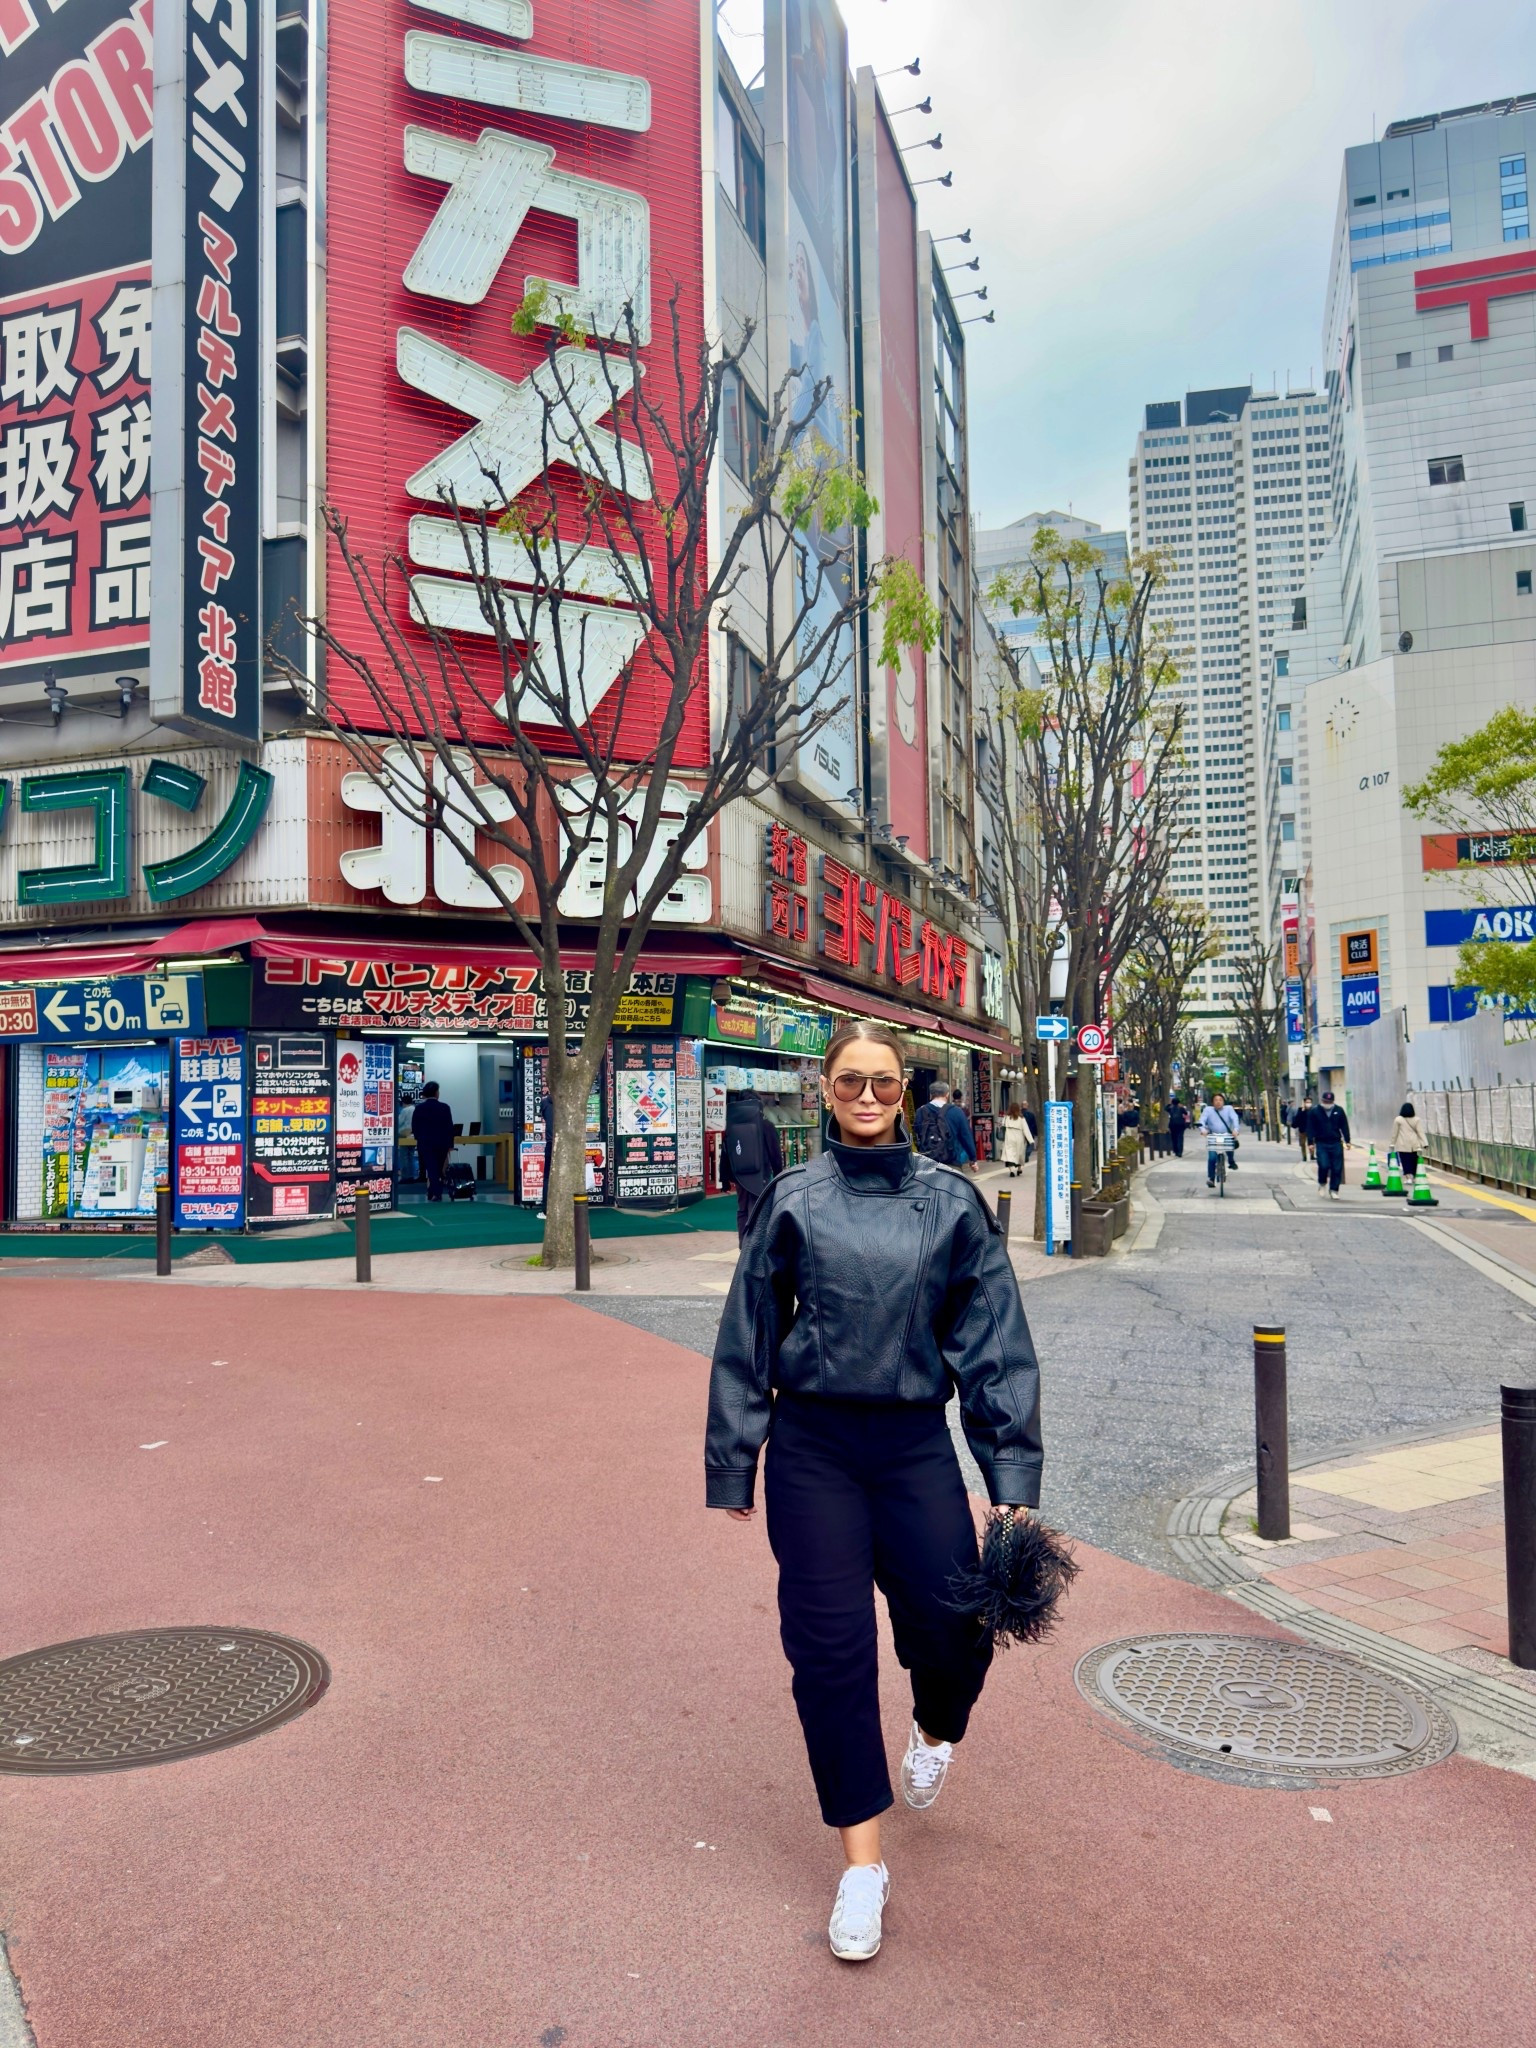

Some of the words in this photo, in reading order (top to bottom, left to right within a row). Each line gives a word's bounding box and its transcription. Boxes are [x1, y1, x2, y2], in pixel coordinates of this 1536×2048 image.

[0, 0, 152, 254] STOR
[813, 743, 841, 783] ASUS
[1372, 771, 1391, 786] 107
[0, 757, 275, 906] コン
[820, 853, 968, 1007] ヨドバシカメラ
[1351, 950, 1369, 960] CLUB
[83, 986, 112, 999] この先
[150, 984, 165, 1007] P
[1346, 991, 1376, 1007] AOKI
[302, 998, 363, 1013] こちらは
[318, 1016, 338, 1026] 主に
[1084, 1033, 1100, 1046] 20
[180, 1038, 242, 1057] ヨドバシ
[180, 1058, 242, 1083] 駐車場
[366, 1069, 391, 1080] テレビ
[217, 1089, 227, 1104] P
[255, 1099, 328, 1115] ネットで注文
[341, 1110, 357, 1119] Shop
[181, 1127, 204, 1138] この先
[181, 1203, 238, 1214] ヨドバシカメラ
